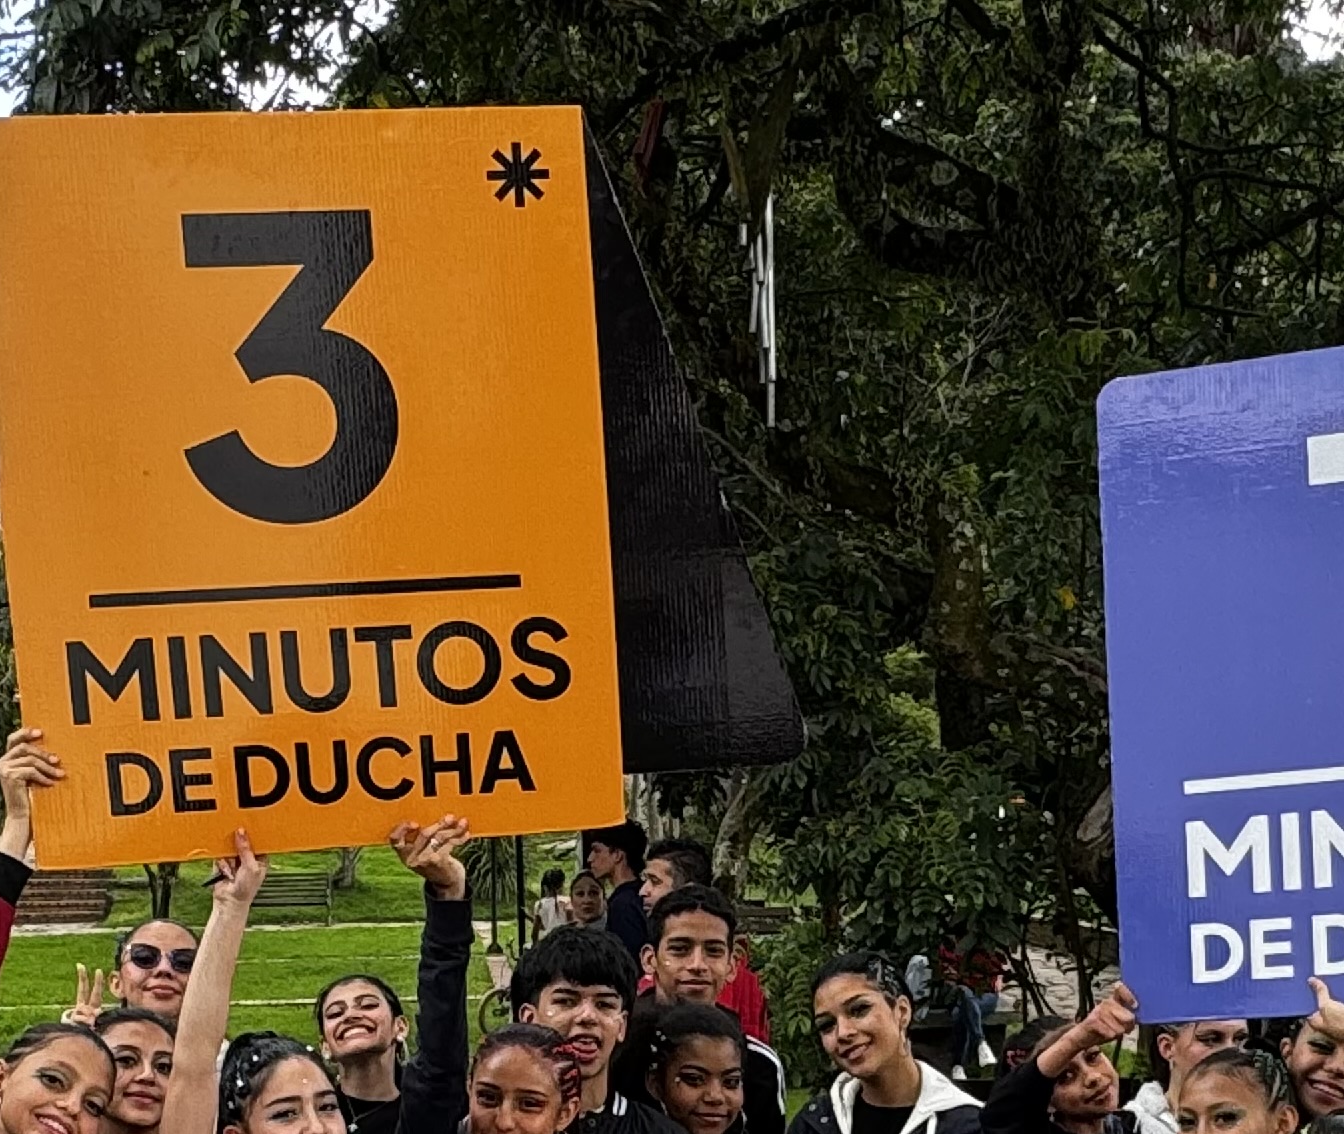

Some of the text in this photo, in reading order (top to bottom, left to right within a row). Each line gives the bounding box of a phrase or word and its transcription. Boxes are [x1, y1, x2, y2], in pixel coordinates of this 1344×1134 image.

[181, 208, 400, 526] 3
[64, 615, 573, 726] MINUTOS
[106, 729, 537, 818] DE DUCHA
[1189, 916, 1296, 985] DE
